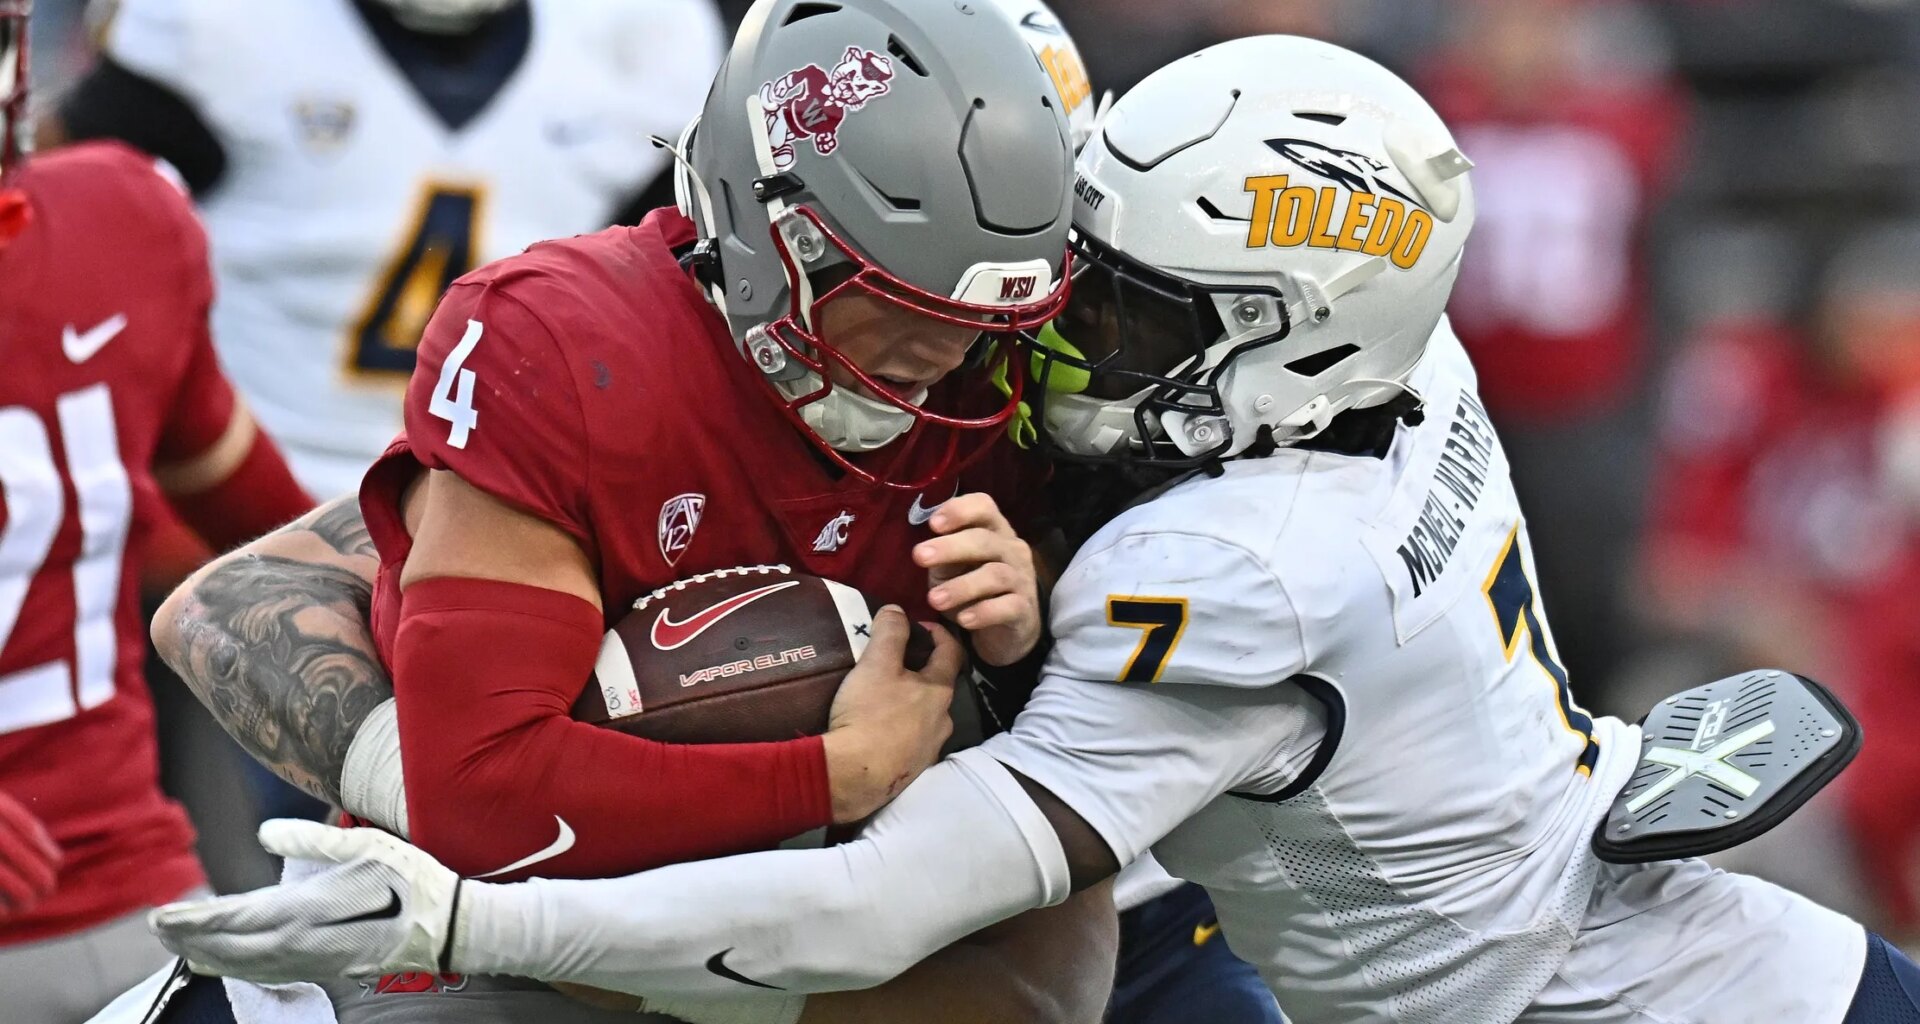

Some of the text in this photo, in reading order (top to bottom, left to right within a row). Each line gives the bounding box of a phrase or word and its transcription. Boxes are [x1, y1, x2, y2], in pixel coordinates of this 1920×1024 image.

[1083, 185, 1105, 210] CITY
[1244, 174, 1434, 269] TOLEDO
[340, 179, 487, 382] 4
[1000, 276, 1036, 298] WSU
[428, 319, 484, 449] 4
[661, 499, 703, 540] PAC
[665, 525, 688, 552] 12
[0, 383, 132, 734] 21
[680, 645, 817, 687] VAPOR ELITE
[1106, 594, 1190, 683] 7
